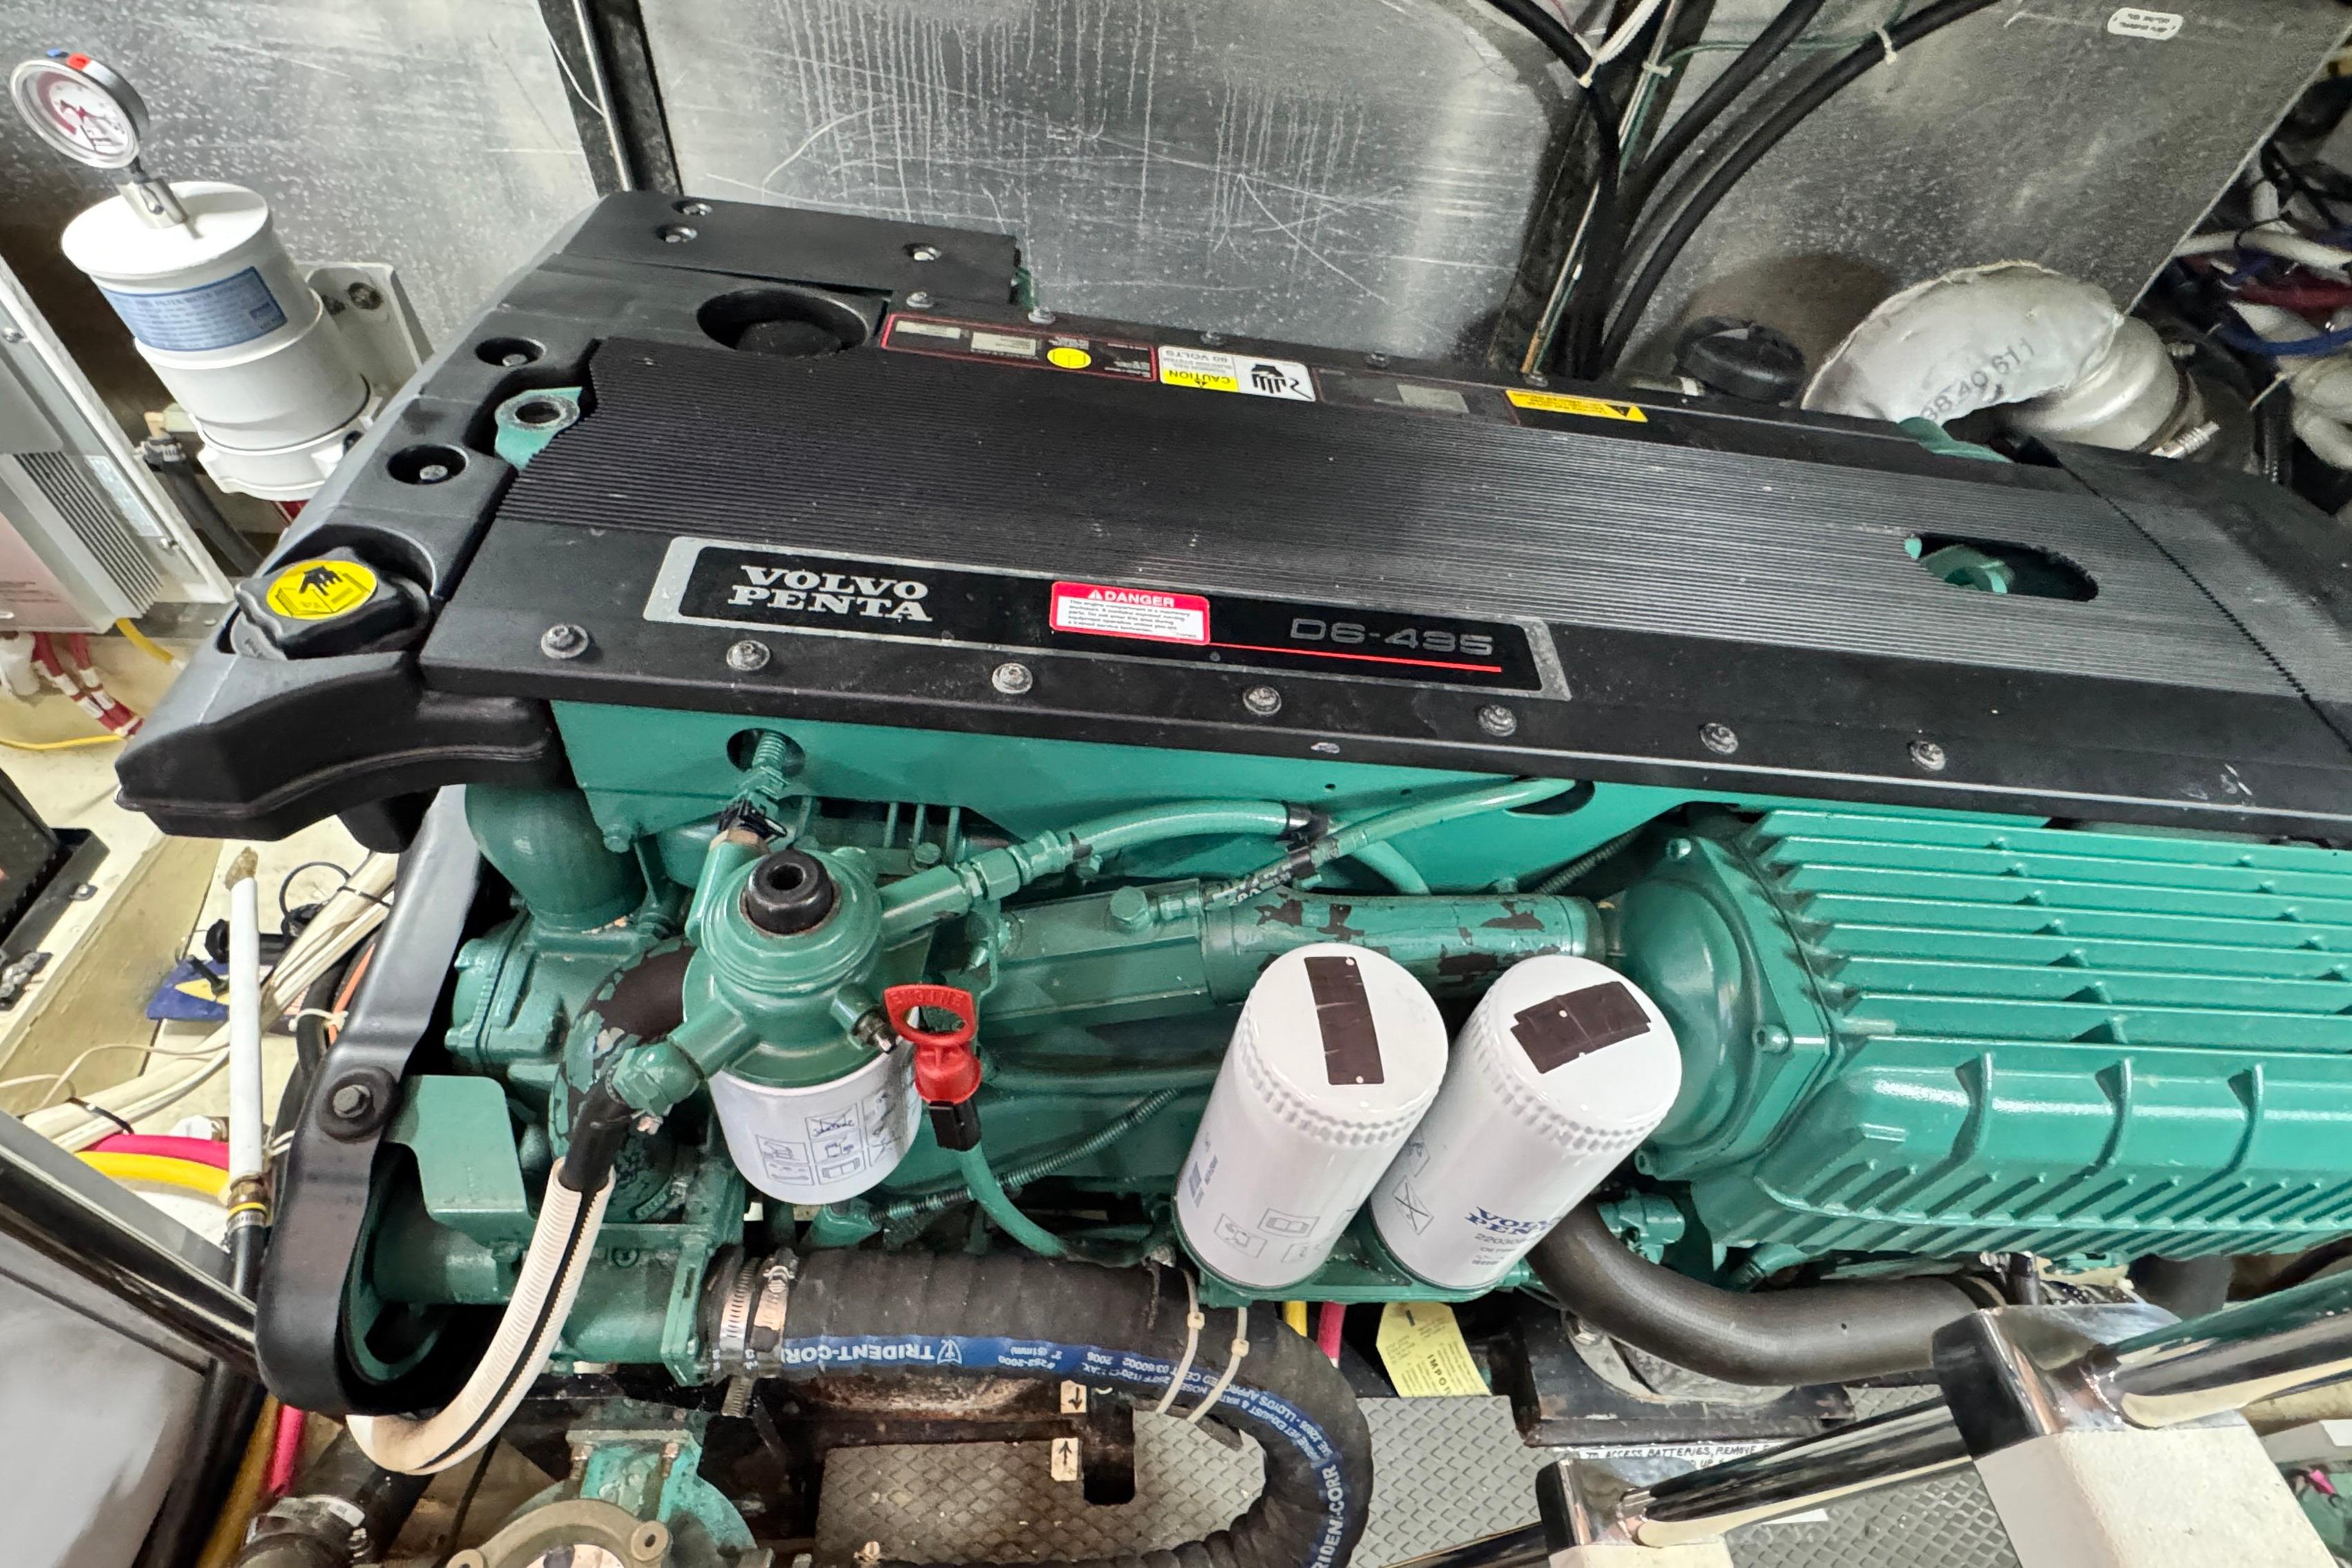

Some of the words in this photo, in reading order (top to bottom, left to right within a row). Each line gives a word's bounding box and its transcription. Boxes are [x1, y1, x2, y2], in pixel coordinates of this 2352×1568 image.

[1168, 369, 1231, 384] CAUTION
[741, 564, 928, 600] VOLVO
[727, 585, 933, 622] PENTA
[1105, 591, 1175, 608] DANGER
[1290, 617, 1493, 655] D6-435
[781, 1343, 935, 1363] TRIDENT-COR
[1170, 1366, 1202, 1382] CET
[1202, 1374, 1260, 1401] APPROED
[1605, 1449, 1643, 1459] ACCESS
